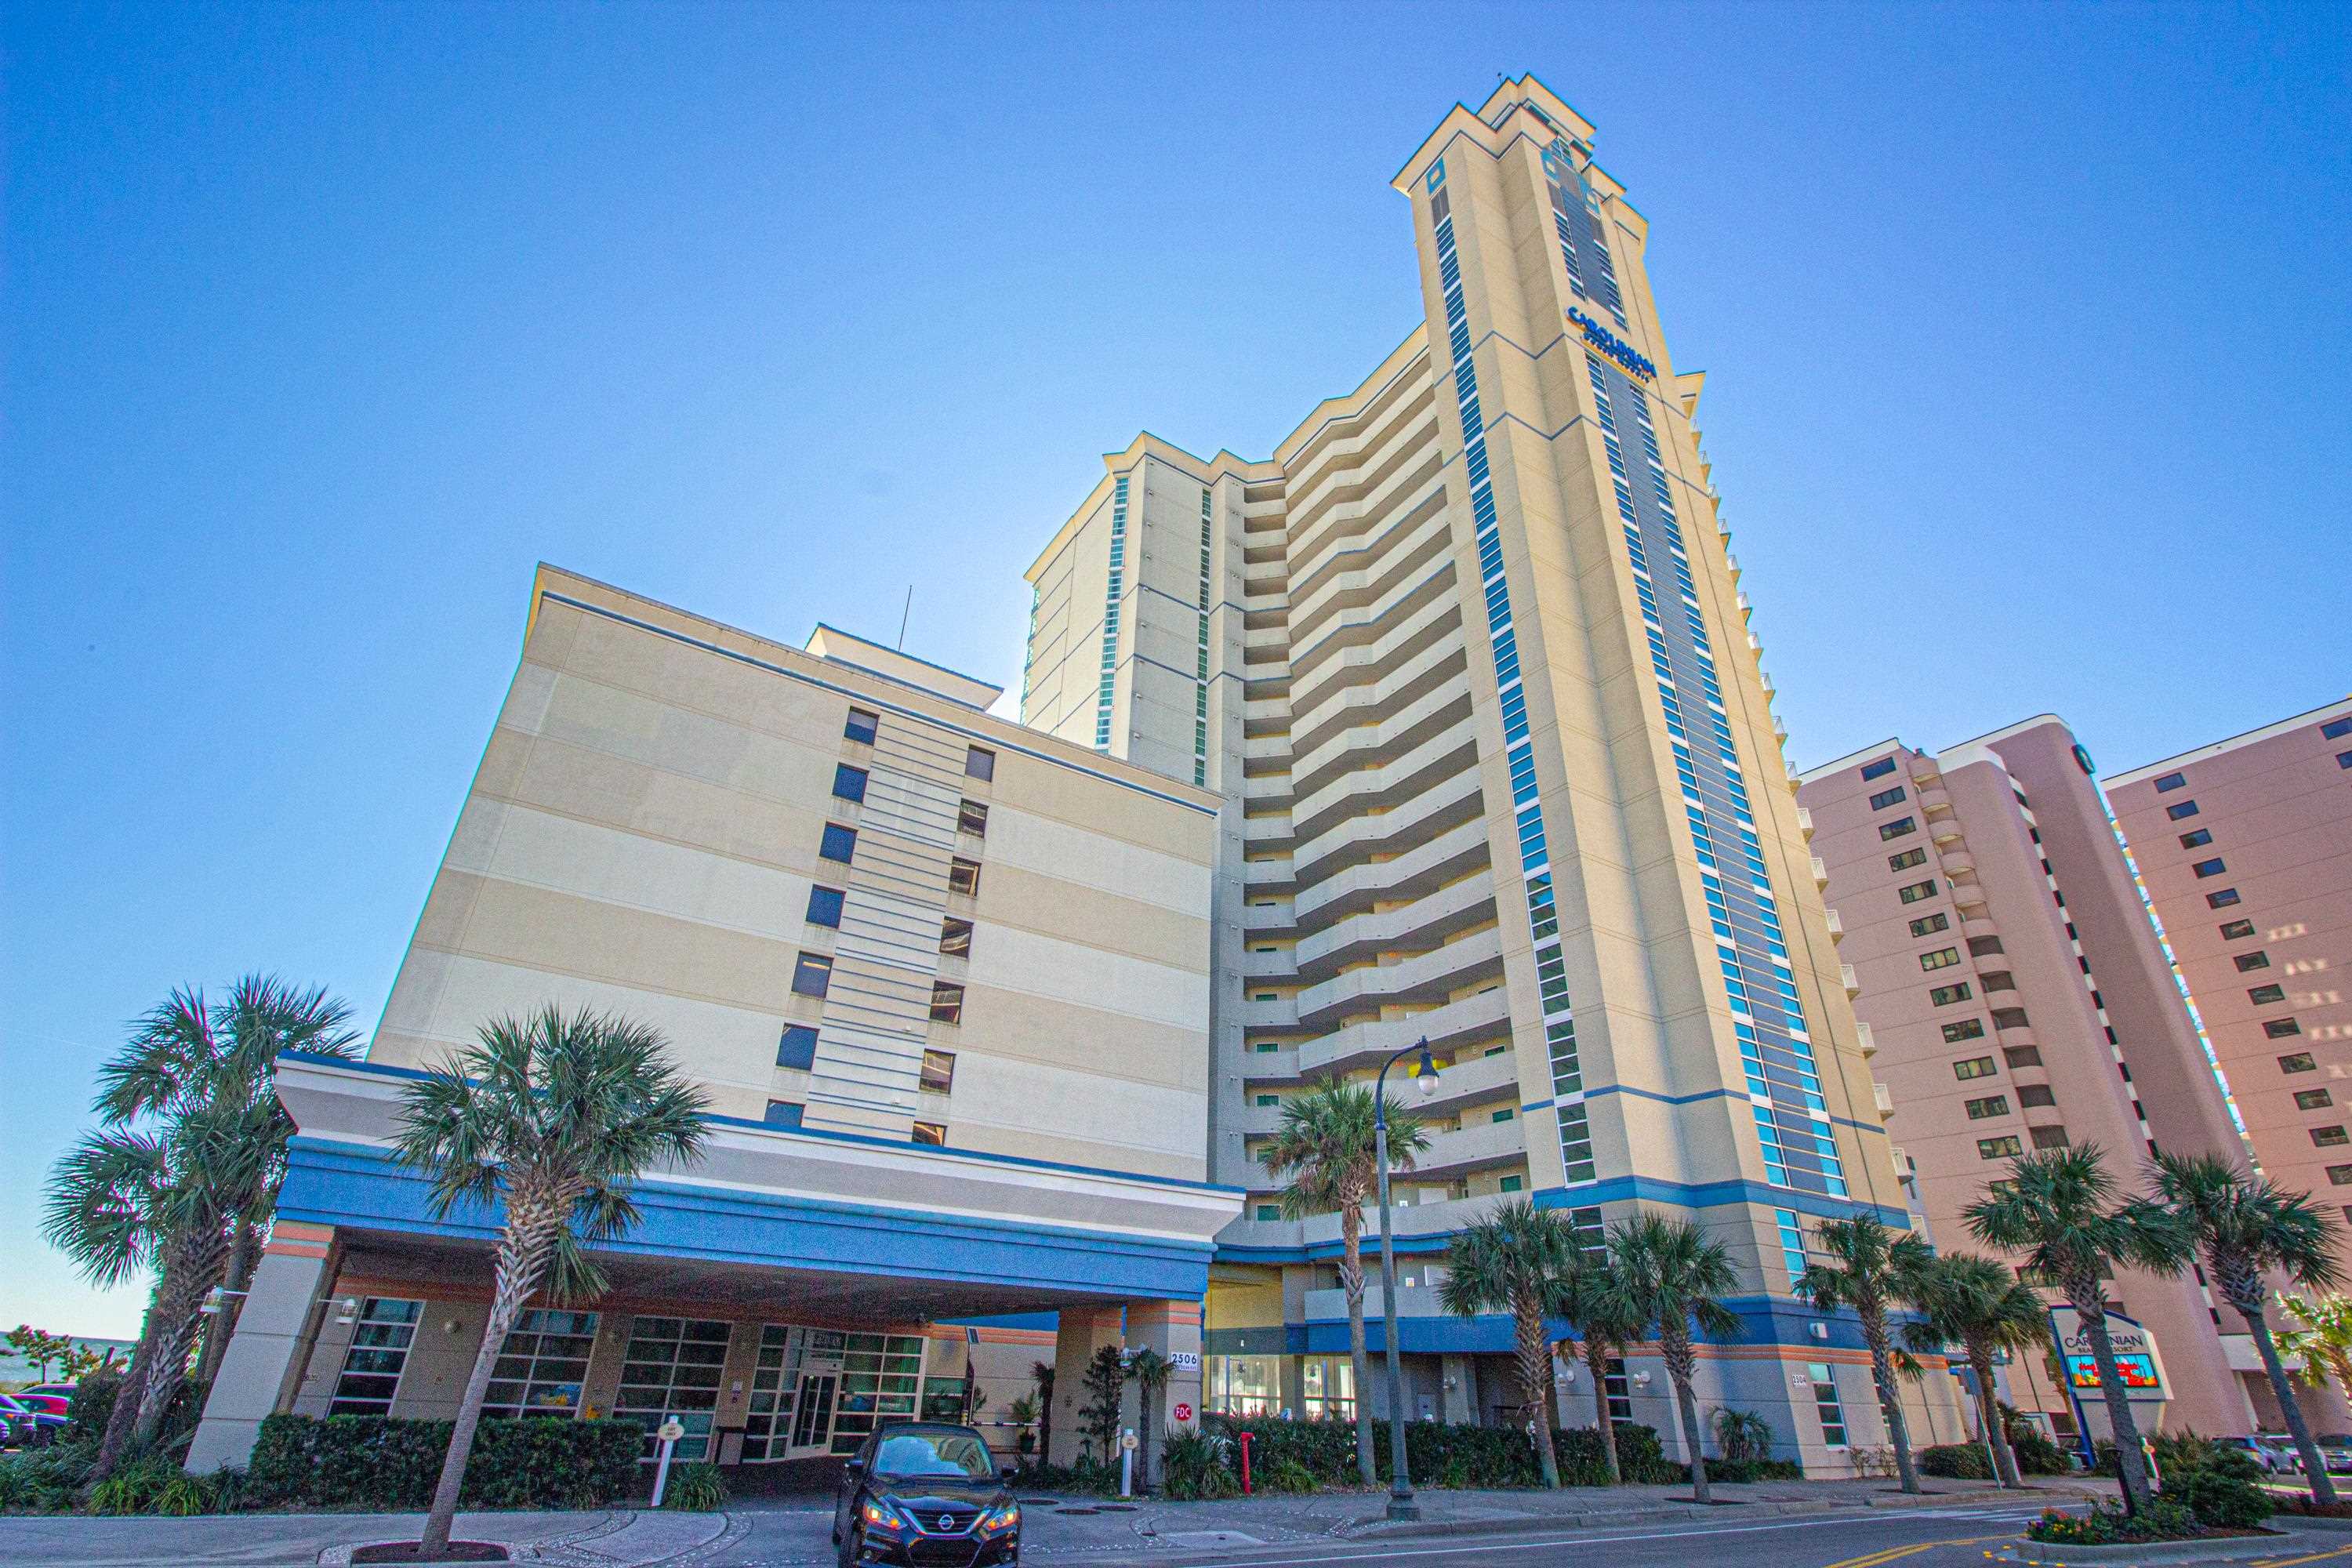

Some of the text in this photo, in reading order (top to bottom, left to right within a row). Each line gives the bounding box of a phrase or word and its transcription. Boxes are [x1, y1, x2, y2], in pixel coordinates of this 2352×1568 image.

[2064, 1335, 2143, 1348] CARNIAN
[1172, 1354, 1197, 1364] 2506
[1176, 1408, 1190, 1418] FDC
